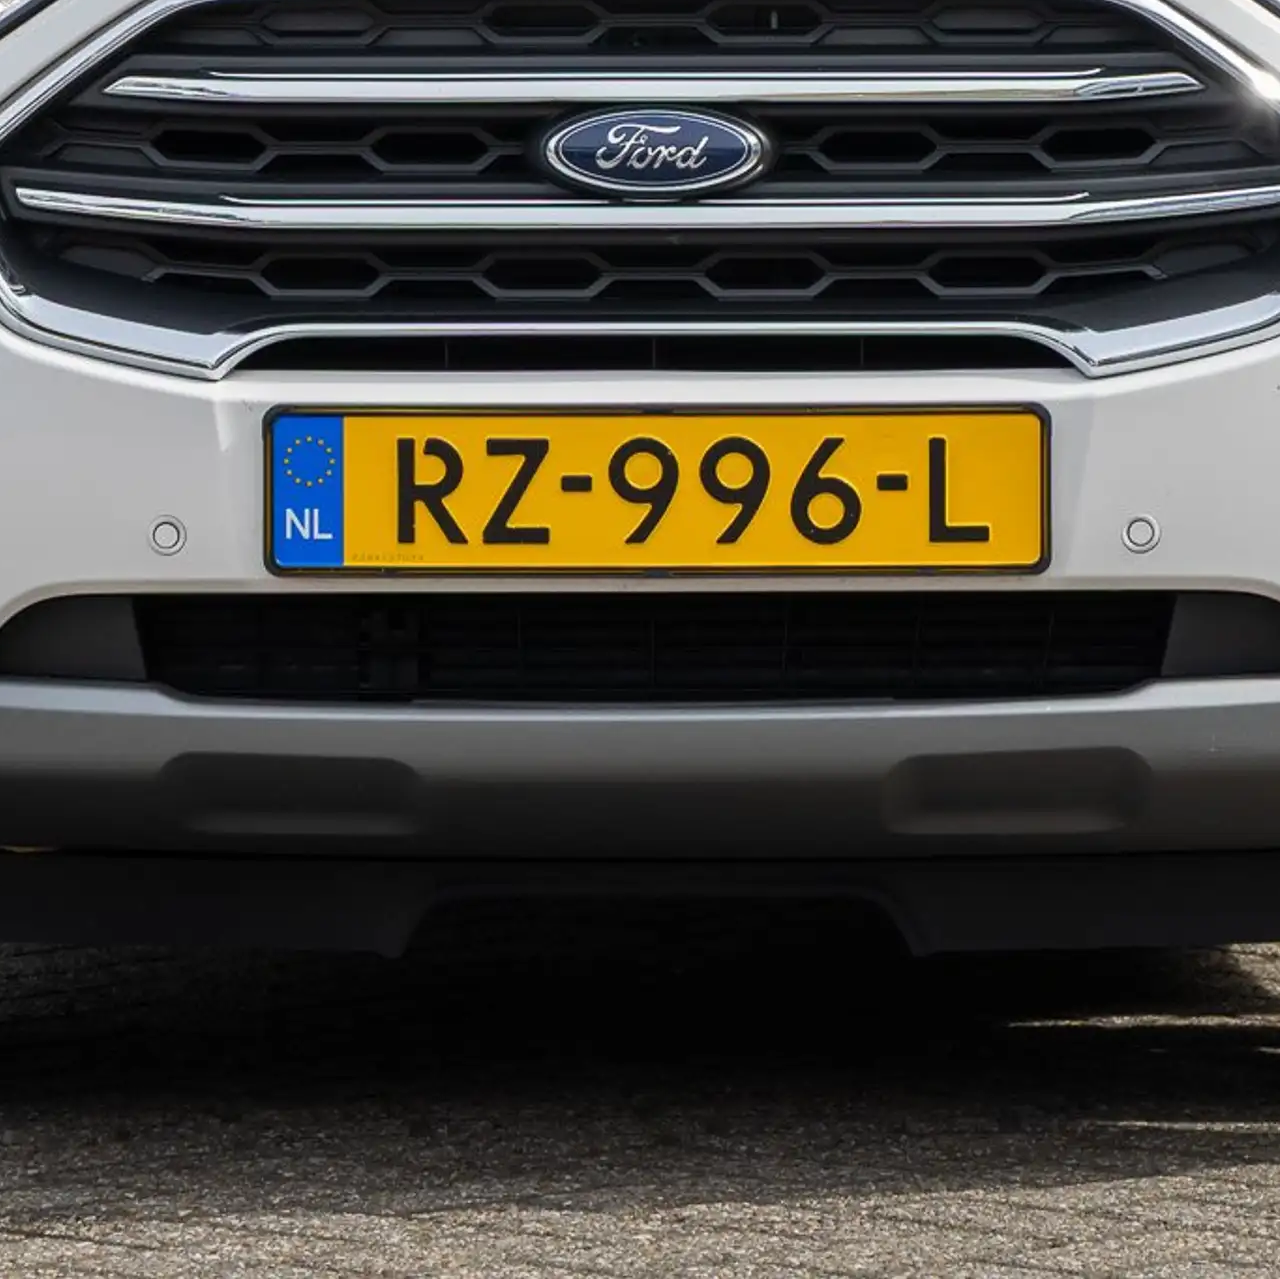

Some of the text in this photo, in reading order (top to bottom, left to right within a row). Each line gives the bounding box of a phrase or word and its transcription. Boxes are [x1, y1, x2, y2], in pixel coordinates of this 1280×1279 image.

[595, 123, 708, 170] Ford
[396, 436, 990, 545] RZ-996-L
[284, 508, 333, 541] NL
